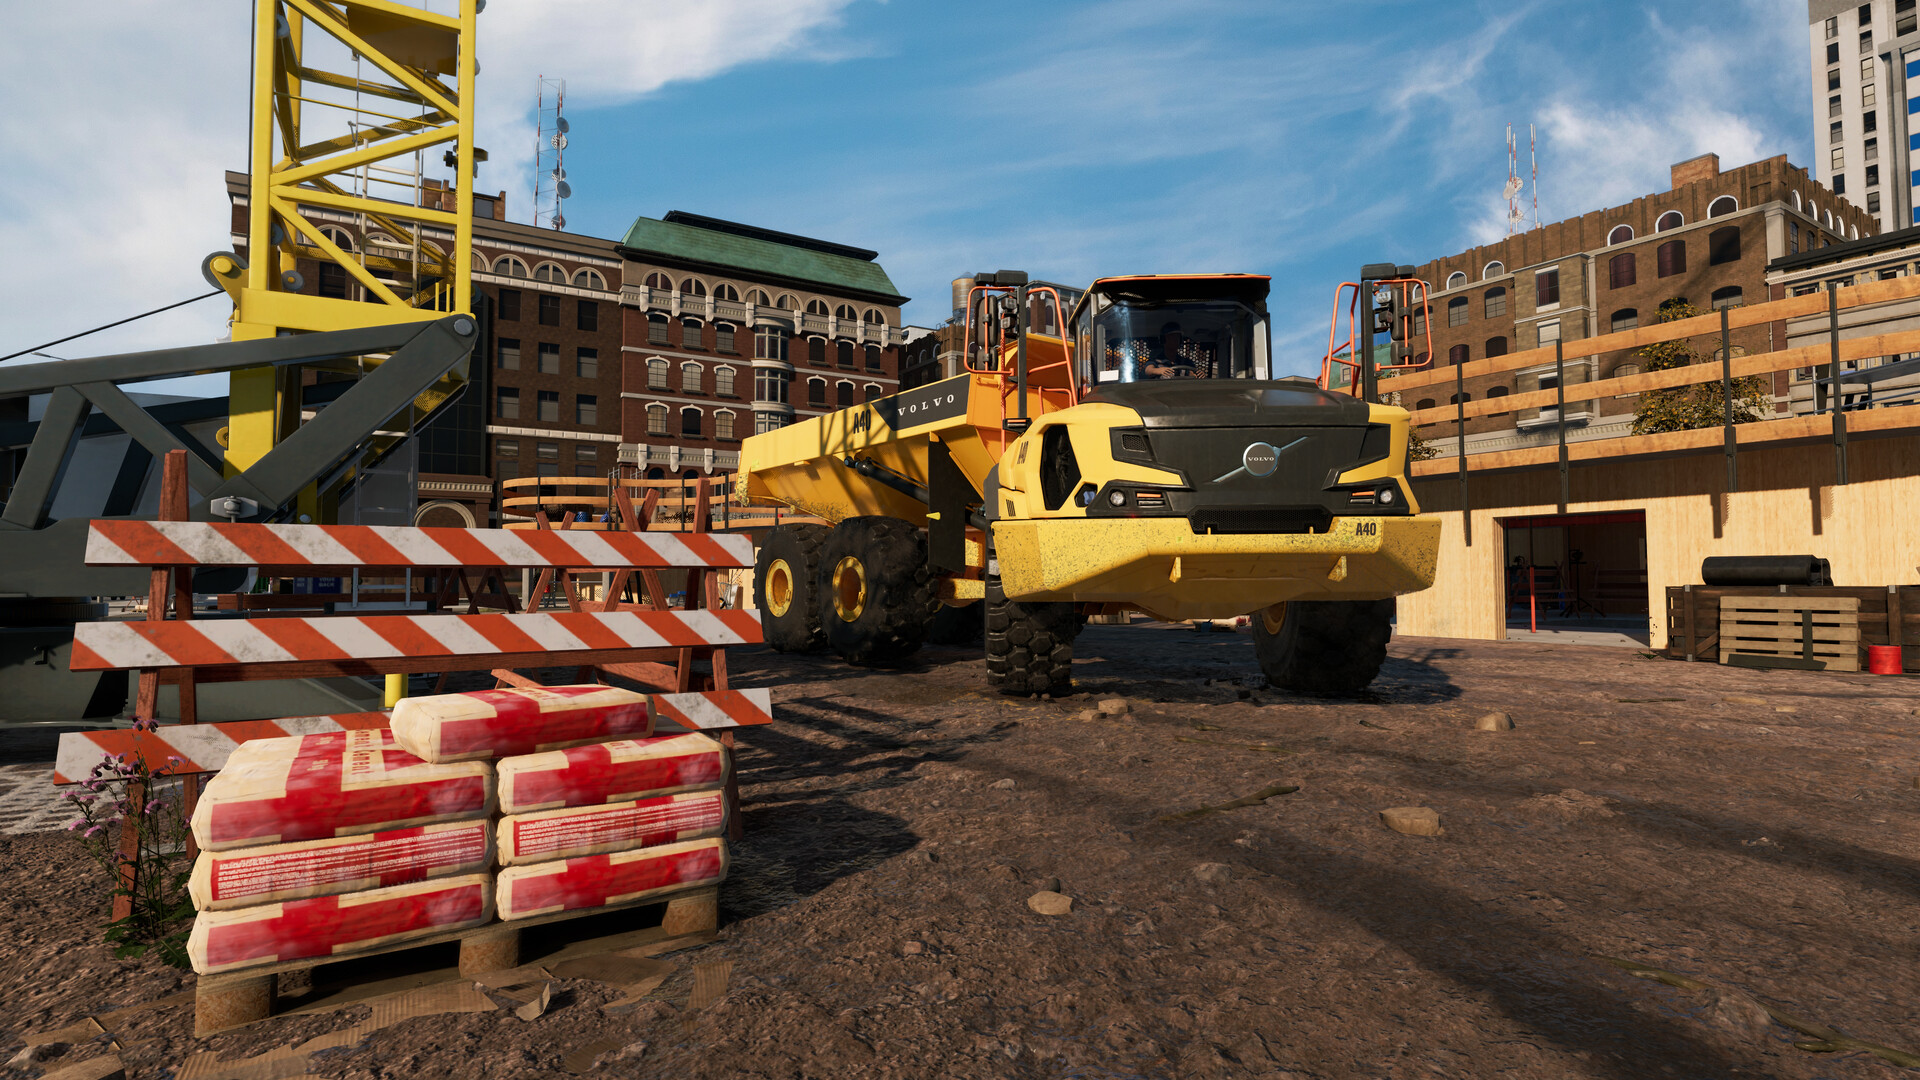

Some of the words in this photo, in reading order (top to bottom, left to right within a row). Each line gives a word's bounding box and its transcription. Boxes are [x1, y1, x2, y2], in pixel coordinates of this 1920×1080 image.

[897, 394, 955, 416] VOLVO
[853, 409, 871, 434] A40
[1356, 522, 1377, 536] A40
